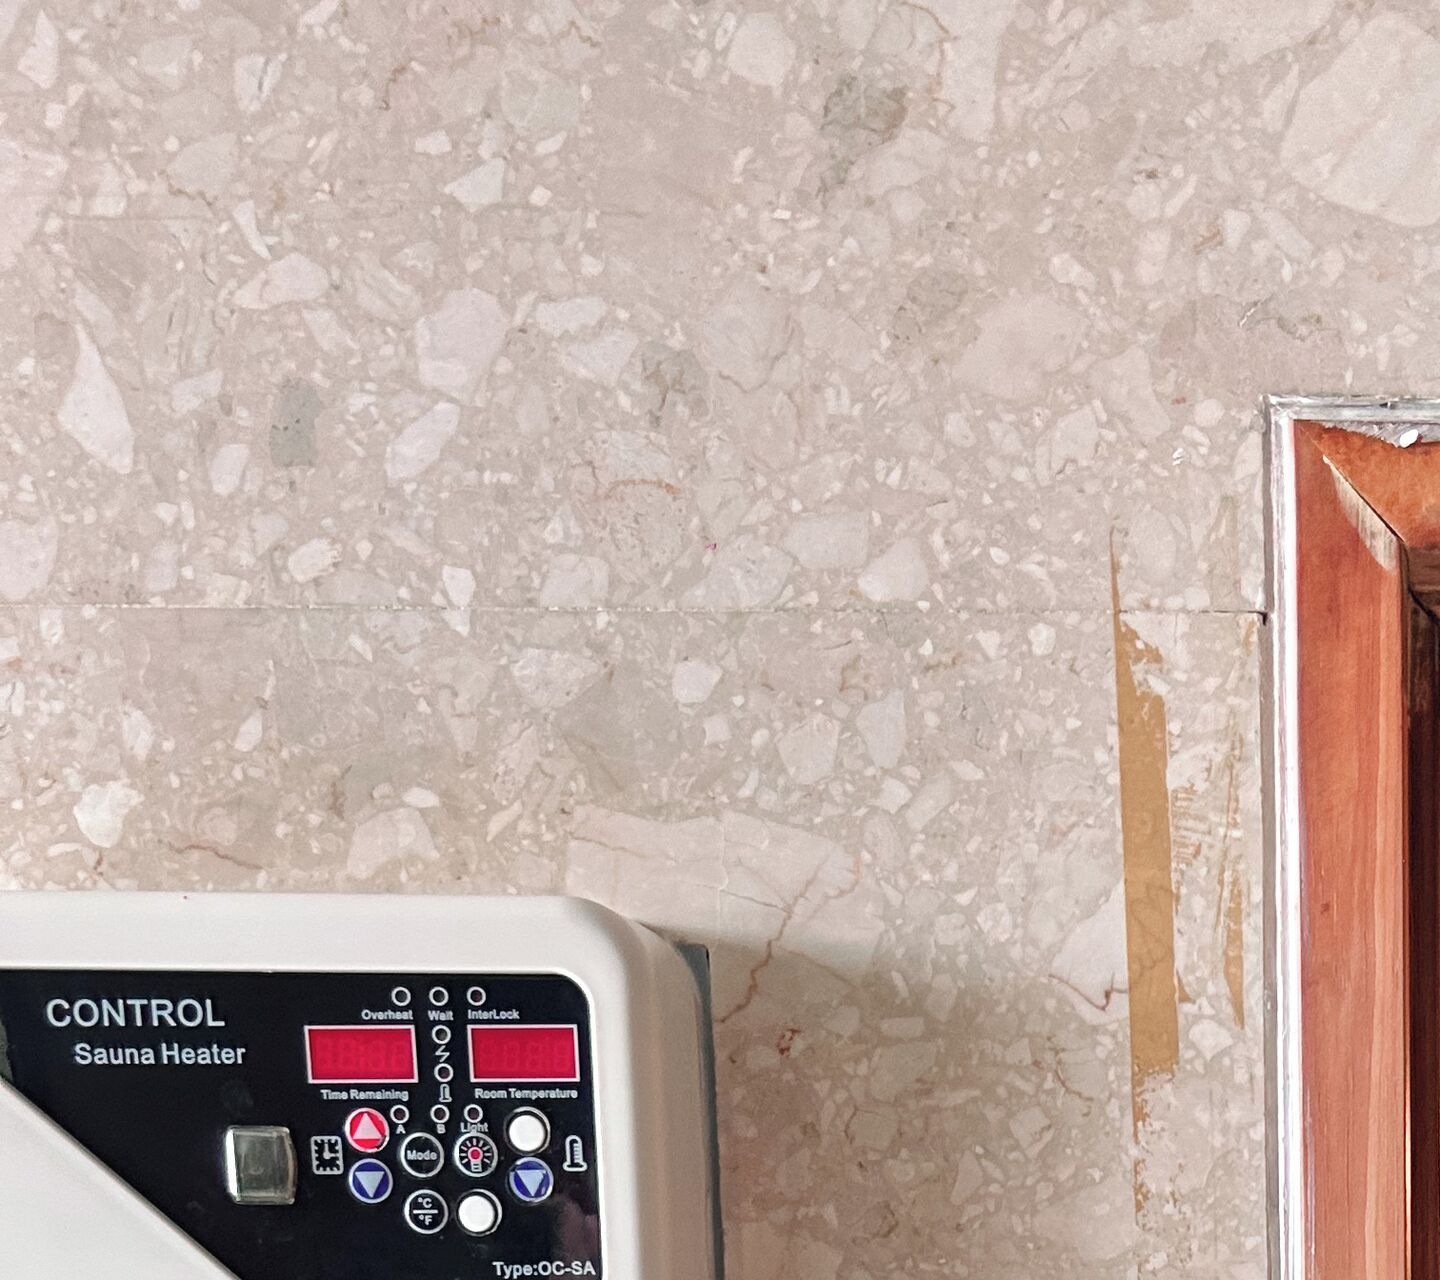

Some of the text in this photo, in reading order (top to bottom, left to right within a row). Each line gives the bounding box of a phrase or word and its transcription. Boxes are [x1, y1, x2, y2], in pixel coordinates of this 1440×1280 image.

[46, 998, 225, 1028] CONTROL
[361, 1009, 414, 1021] Overheat
[427, 1010, 454, 1021] Wait
[468, 1009, 520, 1020] InterLock
[73, 1043, 246, 1065] Sauna Heater
[320, 1089, 409, 1102] Time Remaining
[475, 1088, 579, 1101] Room Temperature
[396, 1124, 406, 1134] A
[437, 1124, 446, 1134] B
[460, 1122, 489, 1133] Light
[406, 1150, 438, 1161] Mode
[492, 1261, 597, 1279] Type:OC-SA
